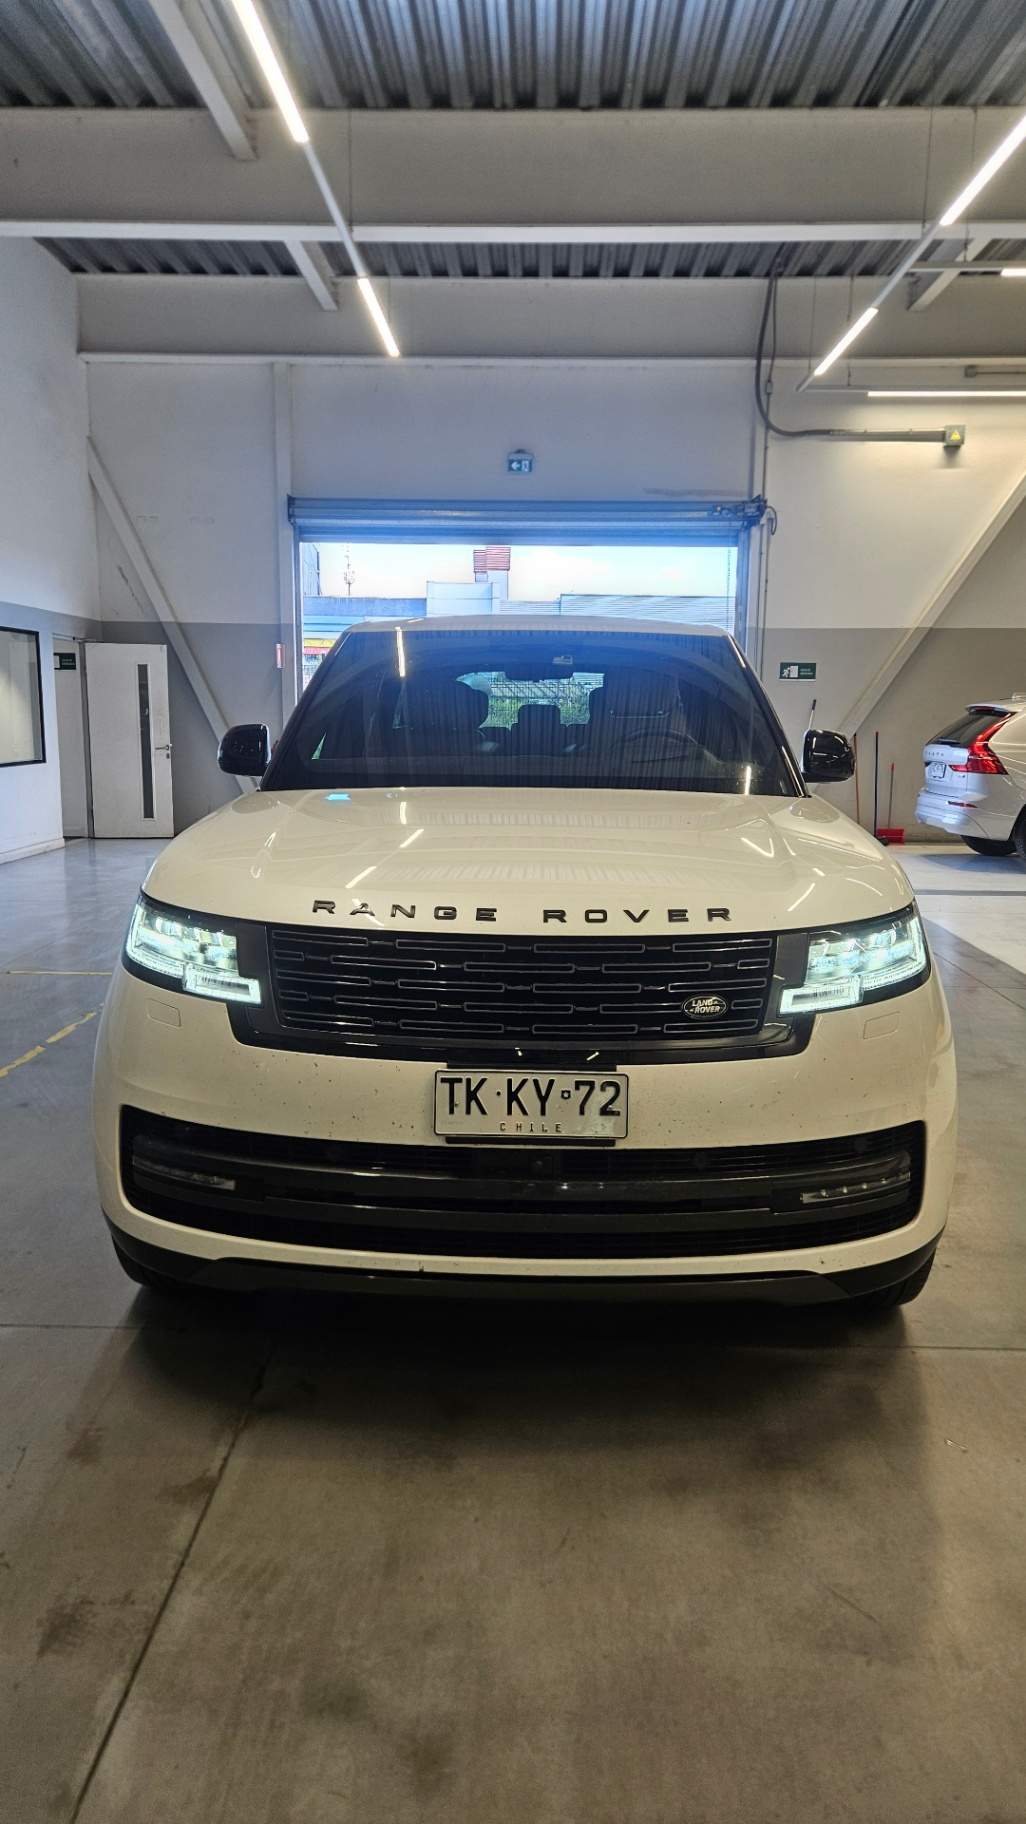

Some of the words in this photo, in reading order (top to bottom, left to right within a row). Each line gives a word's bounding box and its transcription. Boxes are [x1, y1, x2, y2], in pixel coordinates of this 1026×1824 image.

[312, 900, 497, 922] RANGE
[543, 907, 732, 924] ROVER
[692, 999, 713, 1007] LAND
[694, 1005, 721, 1014] ROVER
[500, 1122, 562, 1133] CHILE
